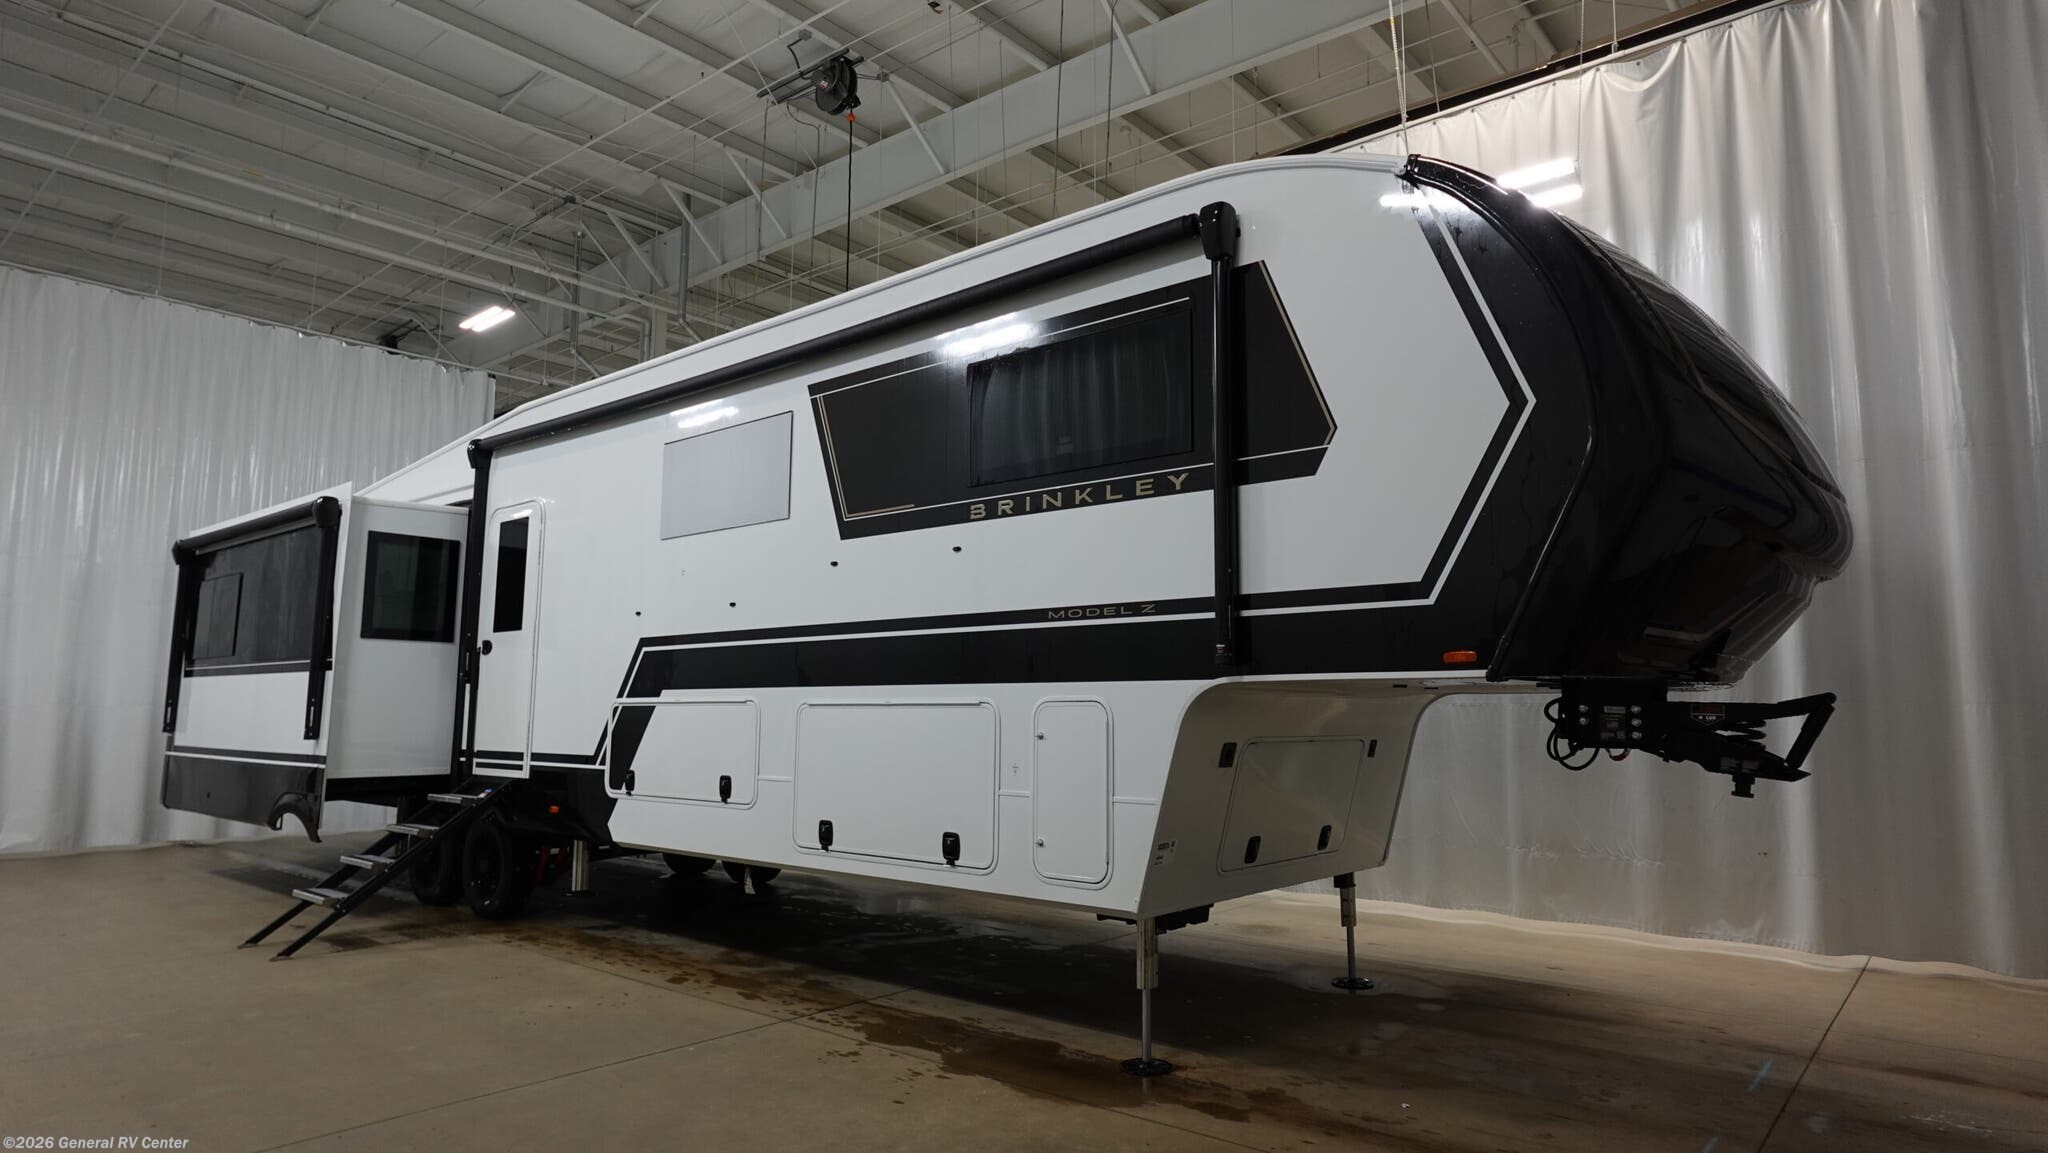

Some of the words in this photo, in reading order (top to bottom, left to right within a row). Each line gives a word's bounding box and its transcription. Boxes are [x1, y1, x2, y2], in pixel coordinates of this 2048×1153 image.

[970, 472, 1189, 519] BRINKLEY
[1048, 606, 1133, 619] MODEL
[1141, 603, 1156, 613] Z
